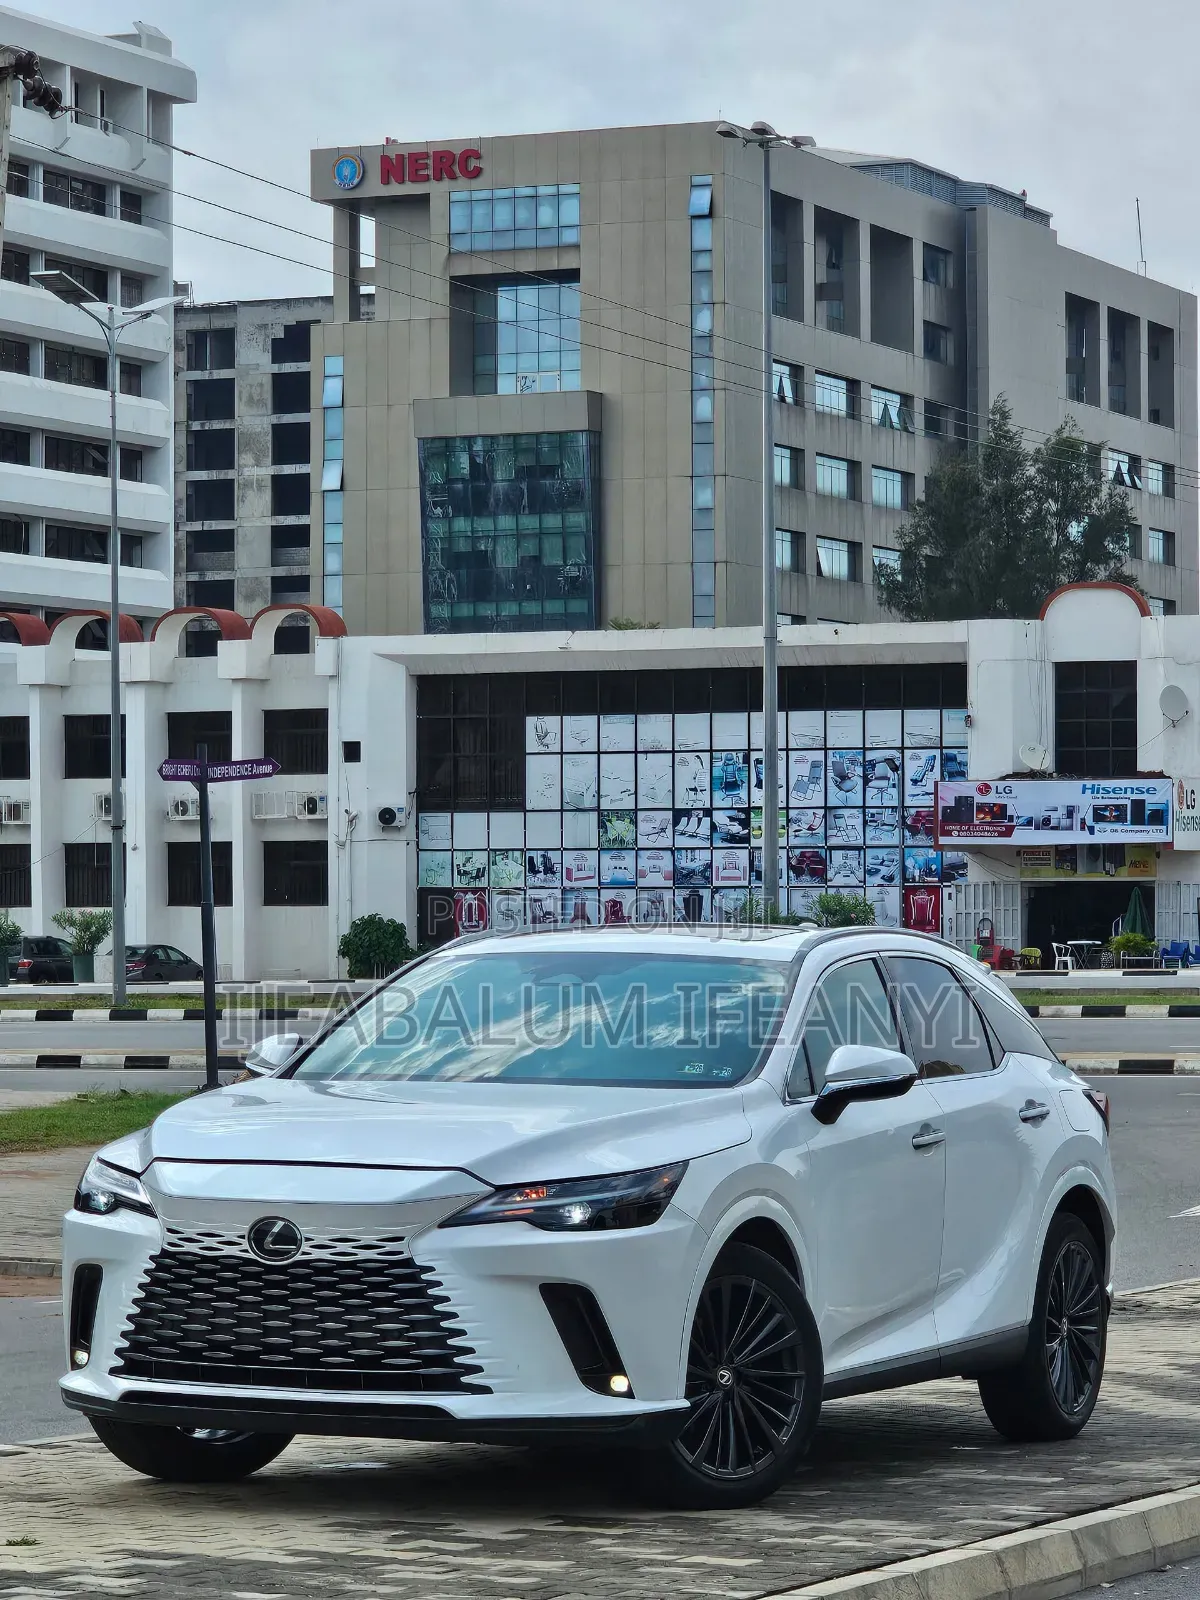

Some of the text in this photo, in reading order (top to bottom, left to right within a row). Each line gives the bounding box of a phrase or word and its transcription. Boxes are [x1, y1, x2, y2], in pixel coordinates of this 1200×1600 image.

[380, 149, 483, 185] NERC
[207, 763, 273, 779] INDEPENDENCE Avenue
[995, 785, 1013, 795] LG
[1081, 783, 1158, 795] Hisense
[1185, 789, 1196, 810] LG
